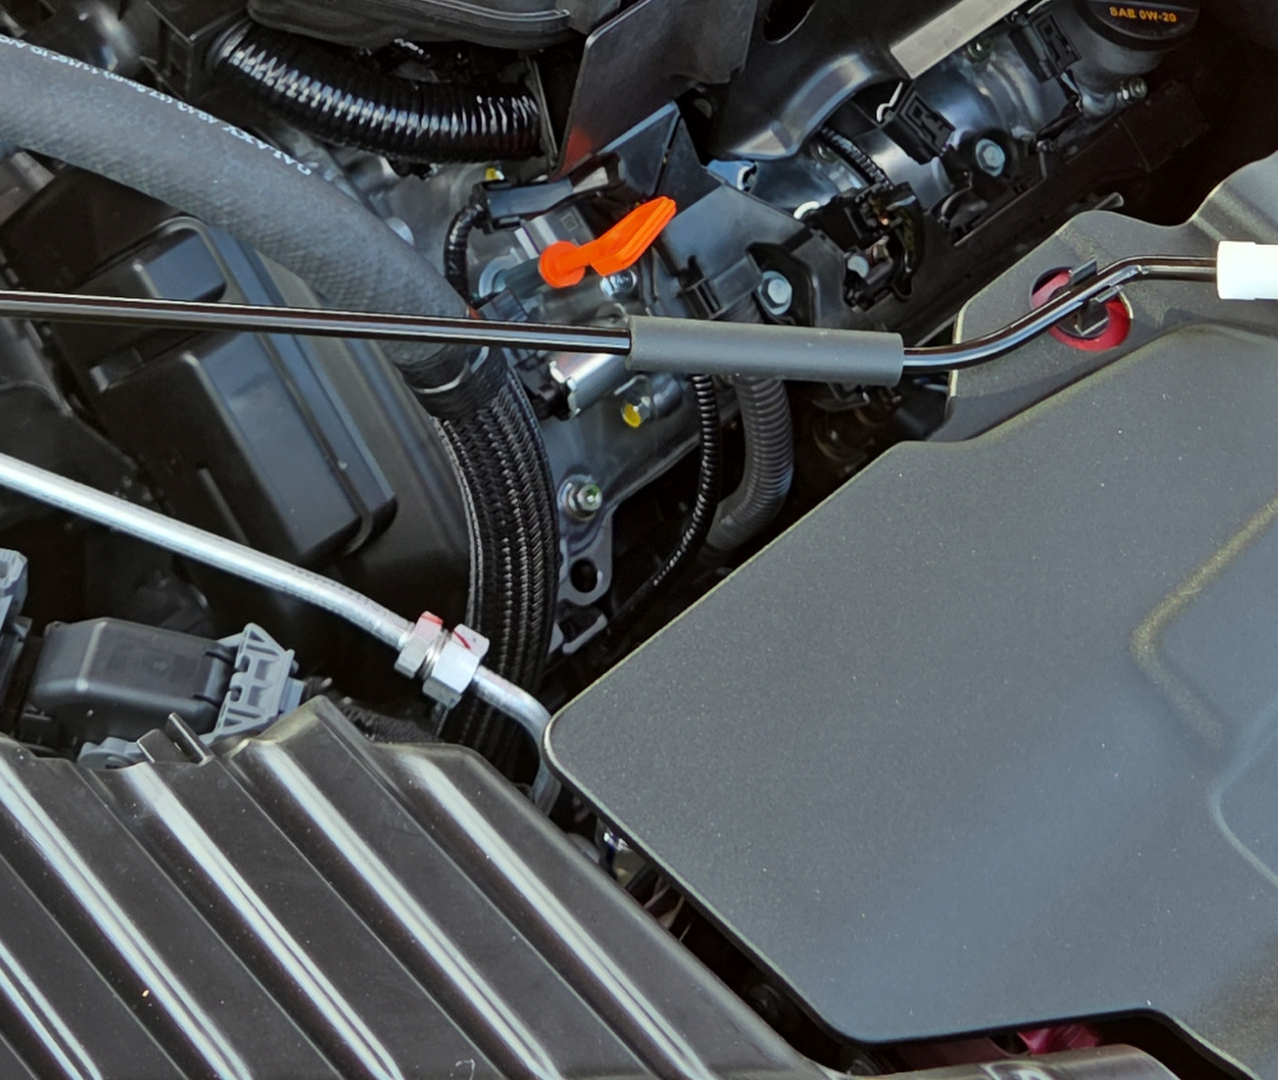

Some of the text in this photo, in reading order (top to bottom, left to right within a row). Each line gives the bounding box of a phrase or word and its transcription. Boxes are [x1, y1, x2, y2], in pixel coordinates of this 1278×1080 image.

[1109, 6, 1178, 23] SAE 0W-20
[222, 124, 312, 176] GALAXY
